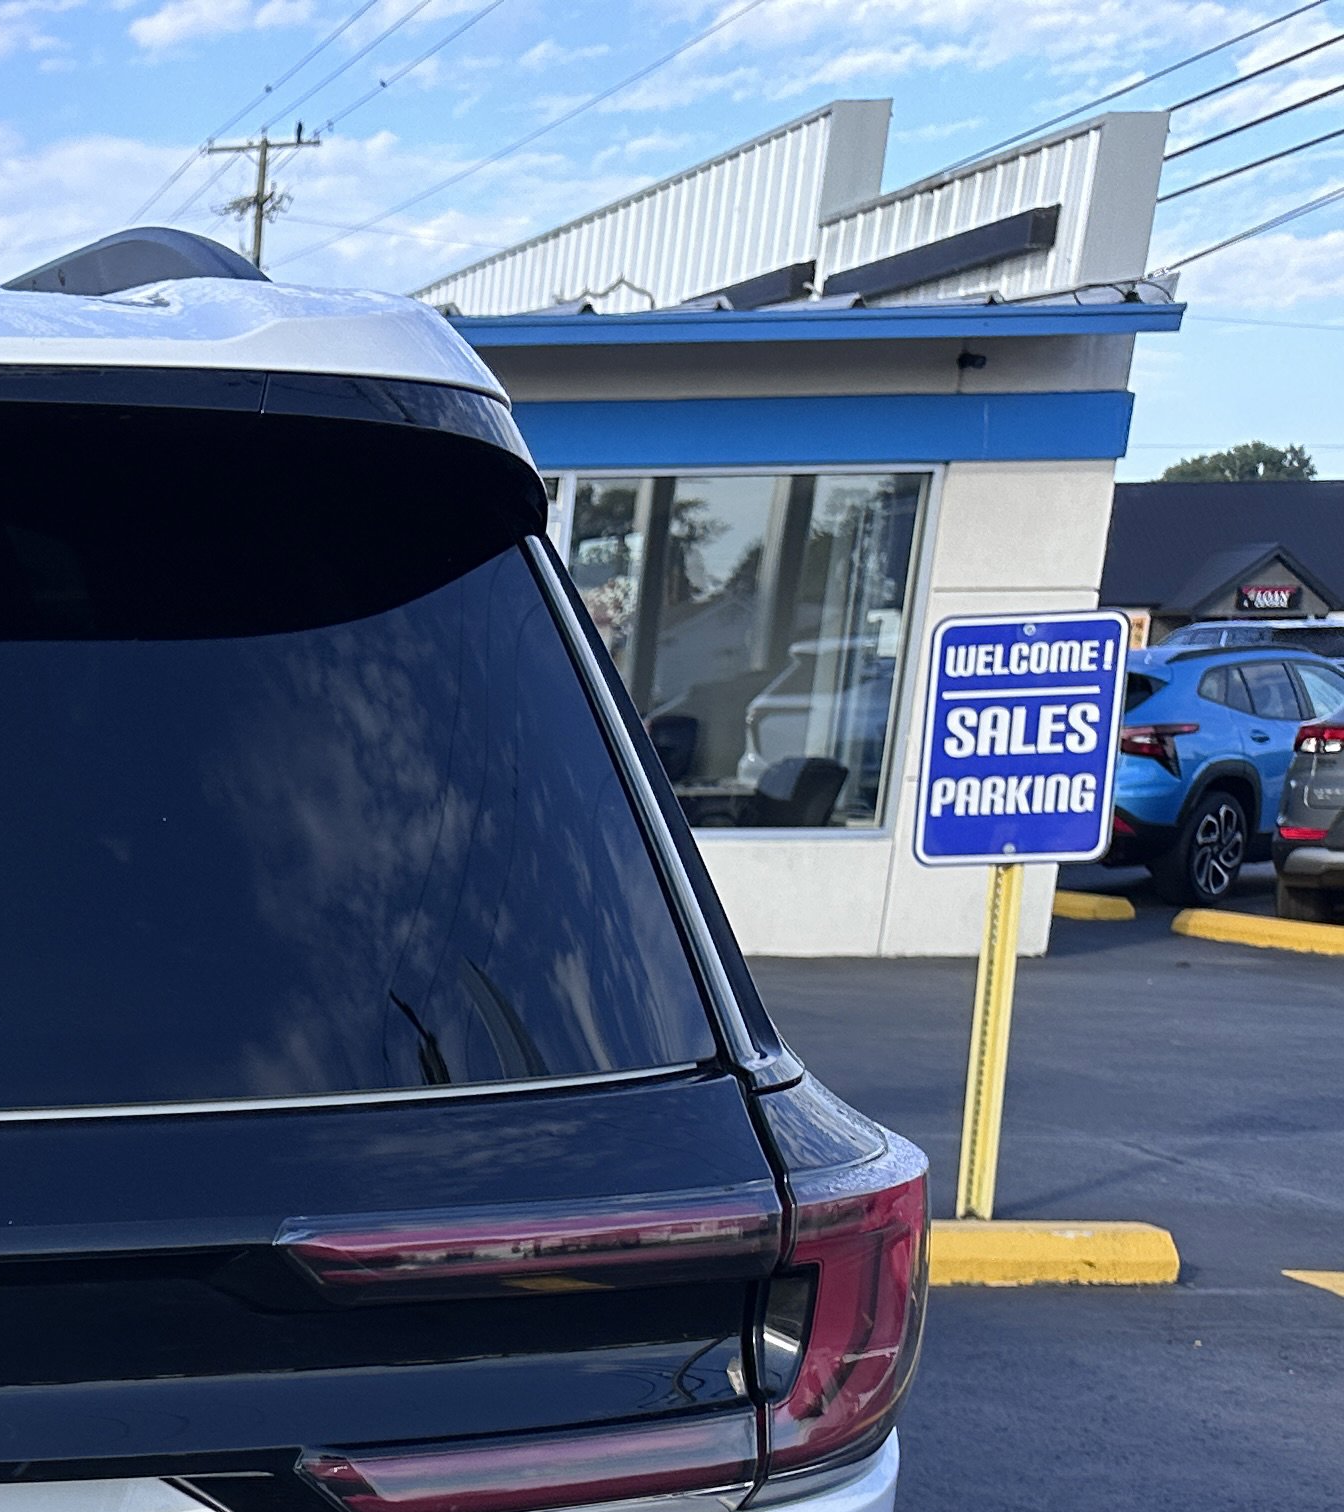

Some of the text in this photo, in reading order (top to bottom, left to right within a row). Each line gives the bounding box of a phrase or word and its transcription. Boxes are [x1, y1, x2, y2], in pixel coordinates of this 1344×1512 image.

[944, 638, 1114, 677] WELCOME!
[943, 702, 1100, 758] SALES
[929, 773, 1097, 818] PARKING
